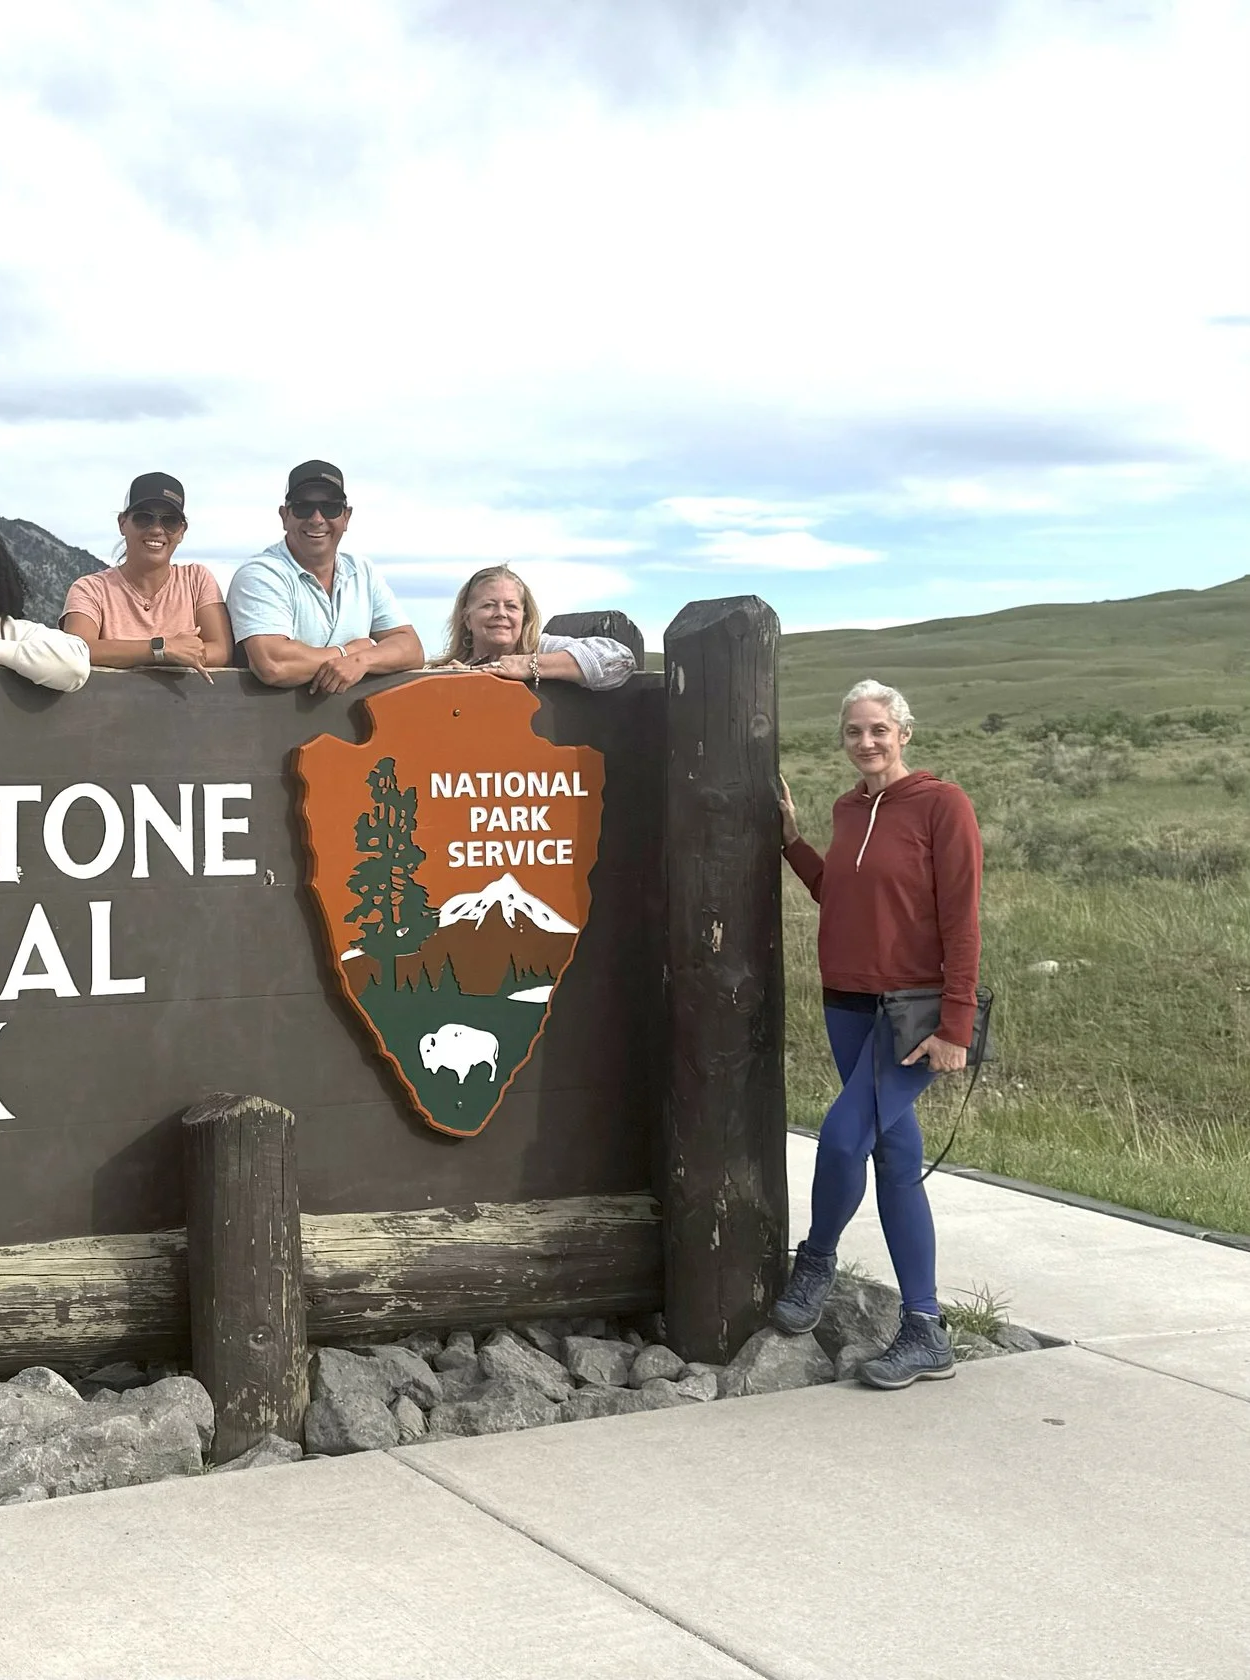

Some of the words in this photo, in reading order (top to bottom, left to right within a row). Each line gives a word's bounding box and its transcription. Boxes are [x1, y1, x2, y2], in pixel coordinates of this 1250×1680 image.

[430, 771, 589, 799] NATIONAL
[470, 805, 551, 833] PARK
[447, 839, 573, 868] SERVICE
